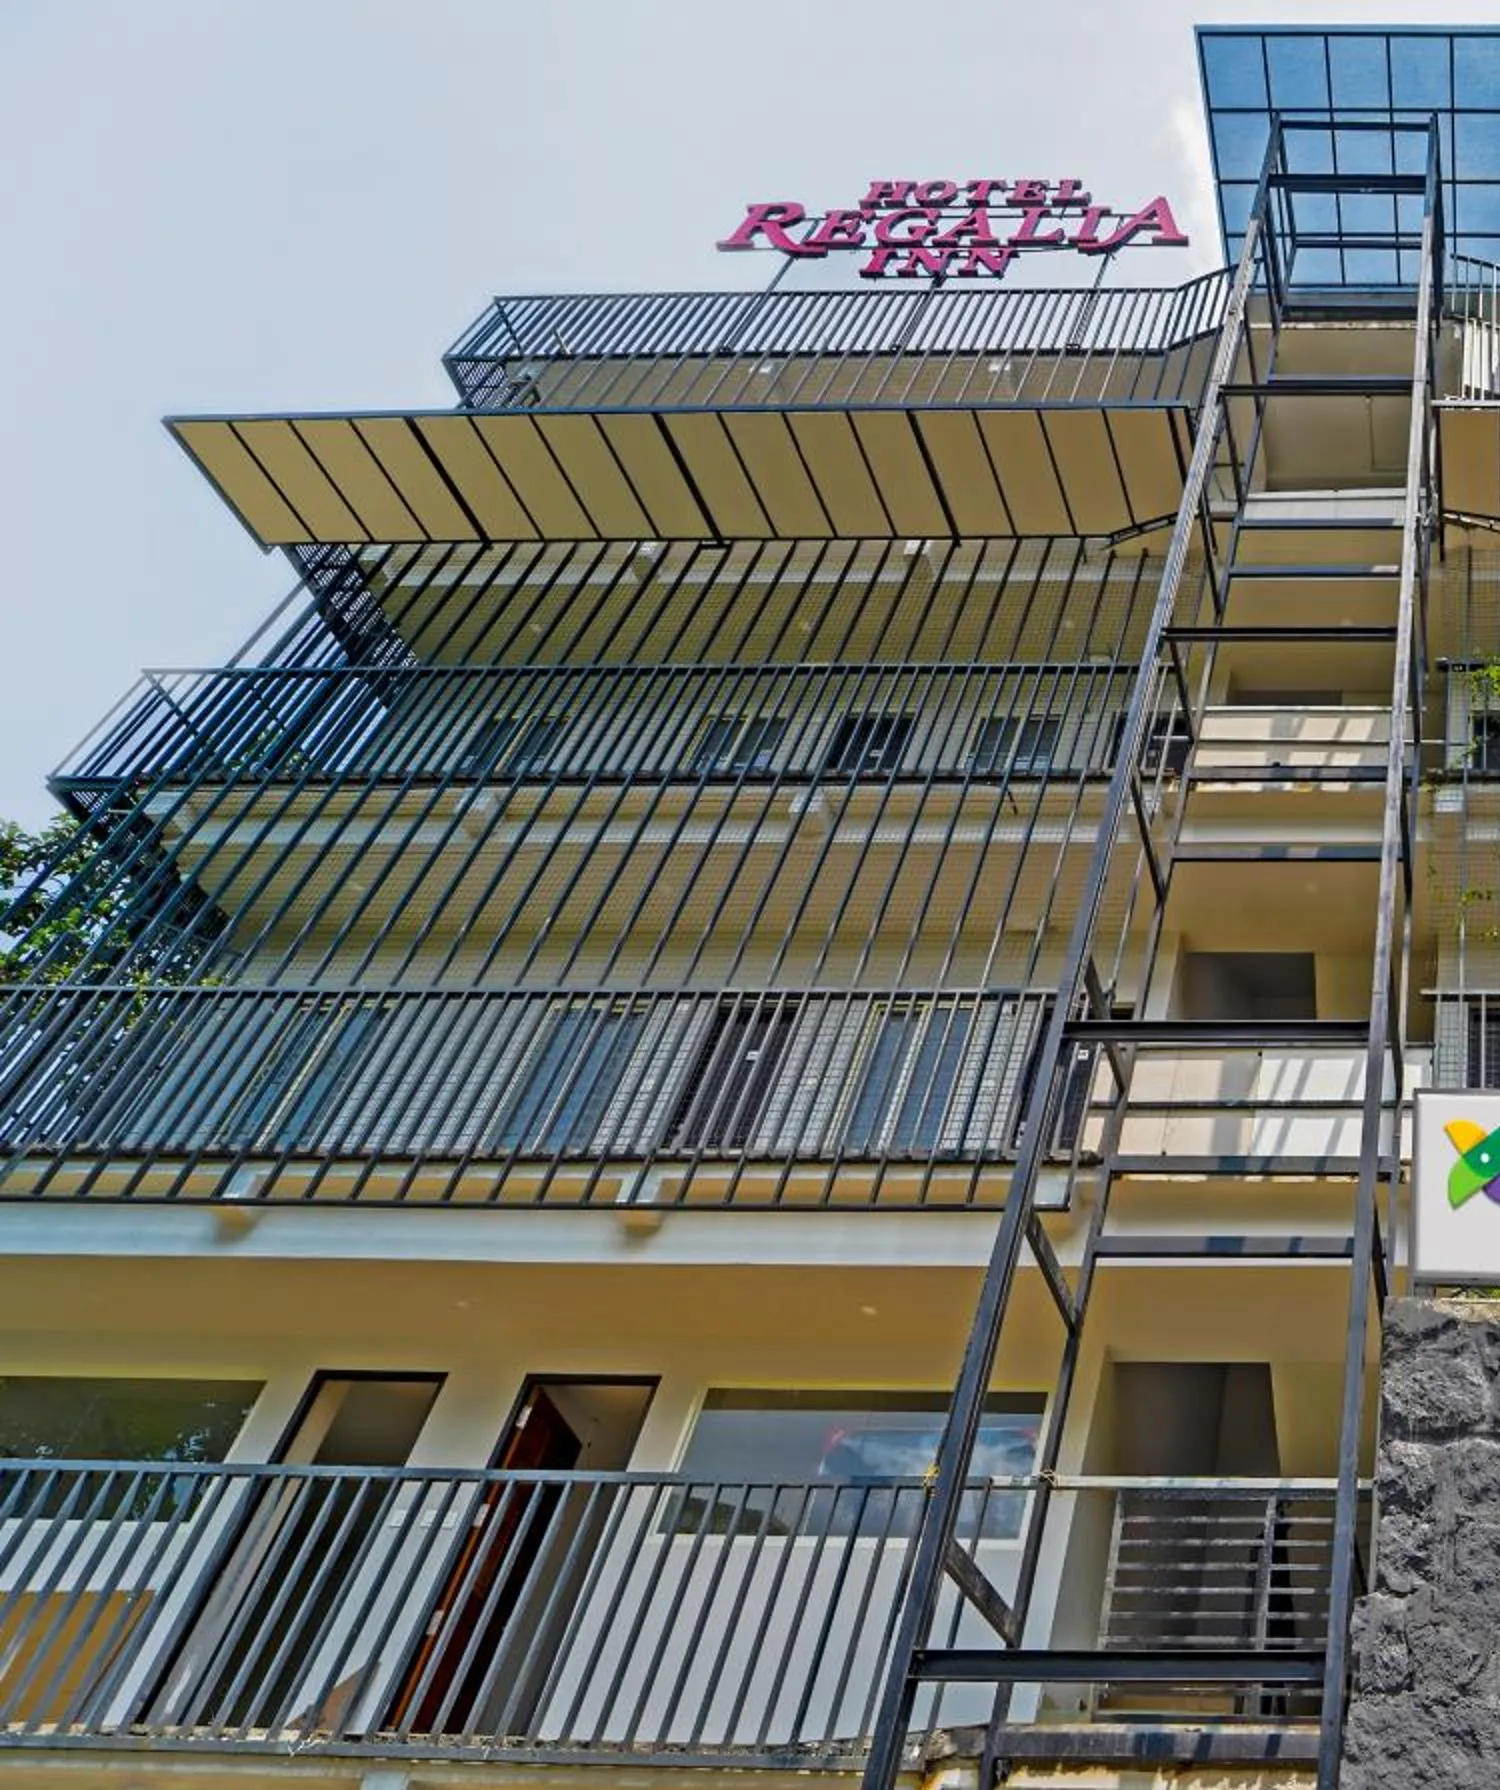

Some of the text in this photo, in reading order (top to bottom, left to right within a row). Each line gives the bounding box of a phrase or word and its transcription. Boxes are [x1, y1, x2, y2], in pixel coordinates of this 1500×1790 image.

[859, 179, 1092, 208] HOTEL
[716, 195, 1189, 258] REGALIA
[858, 247, 1020, 278] INN
